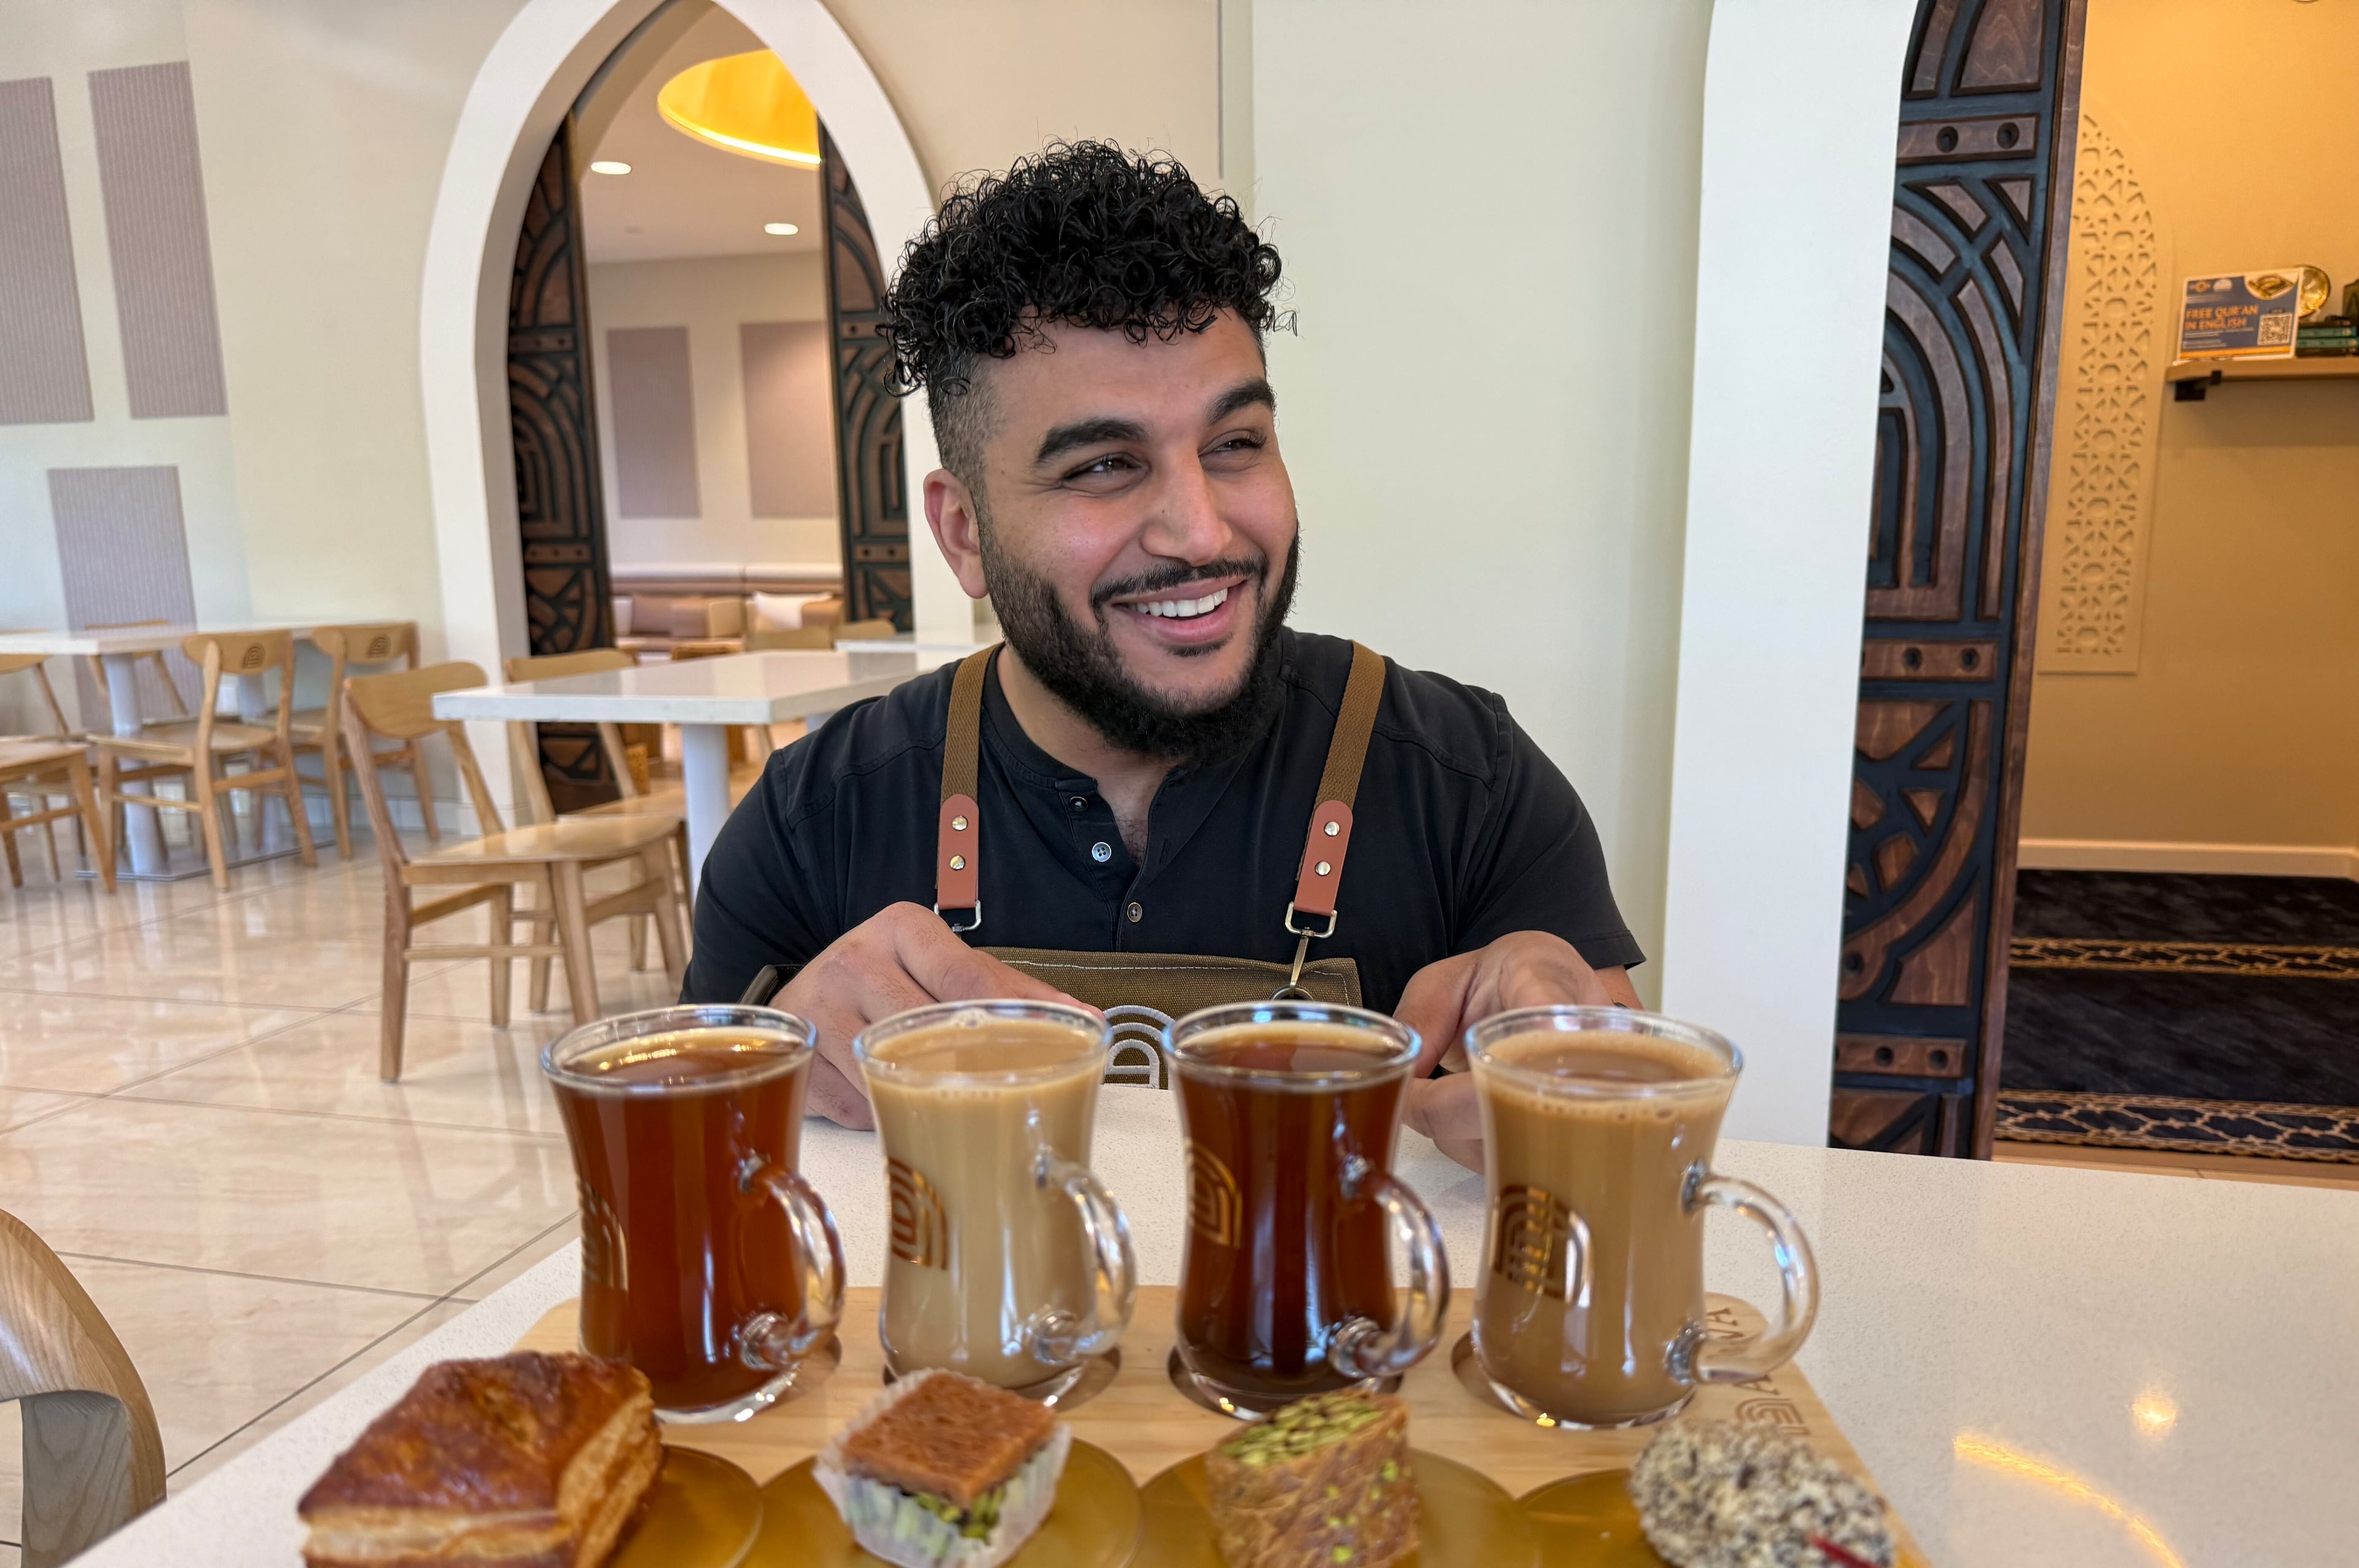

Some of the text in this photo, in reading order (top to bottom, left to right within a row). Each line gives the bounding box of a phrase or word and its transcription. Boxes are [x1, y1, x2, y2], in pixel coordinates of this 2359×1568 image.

[2186, 308, 2212, 319] FREE
[2215, 305, 2258, 317] QUR'AN
[2185, 318, 2247, 330] IN ENGLISH
